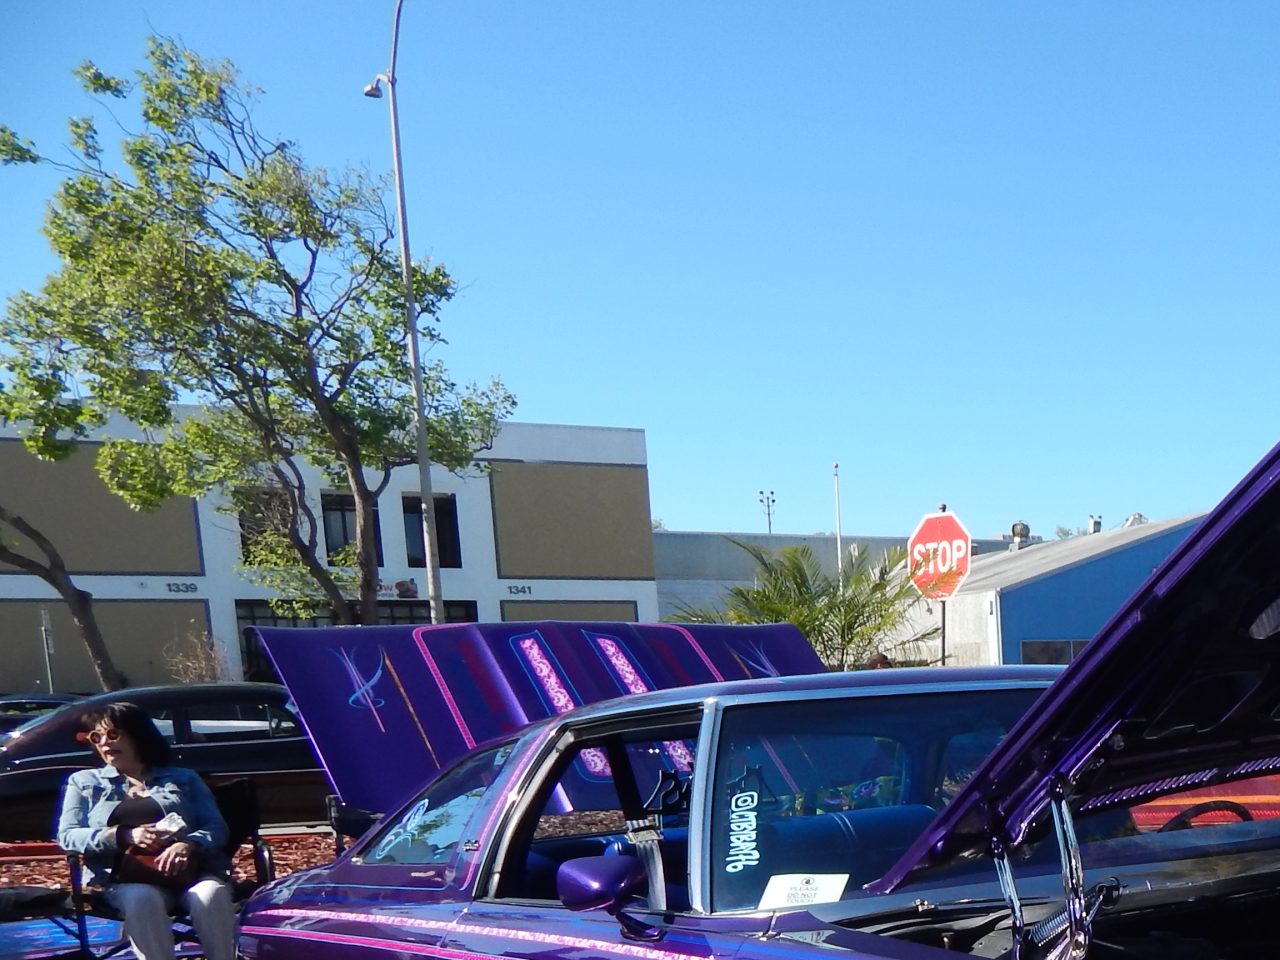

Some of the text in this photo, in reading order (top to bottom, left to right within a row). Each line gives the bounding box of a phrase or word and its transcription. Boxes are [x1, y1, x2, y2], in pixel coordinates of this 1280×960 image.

[913, 540, 967, 575] STOP
[166, 582, 198, 593] 1339
[507, 585, 532, 595] 1341
